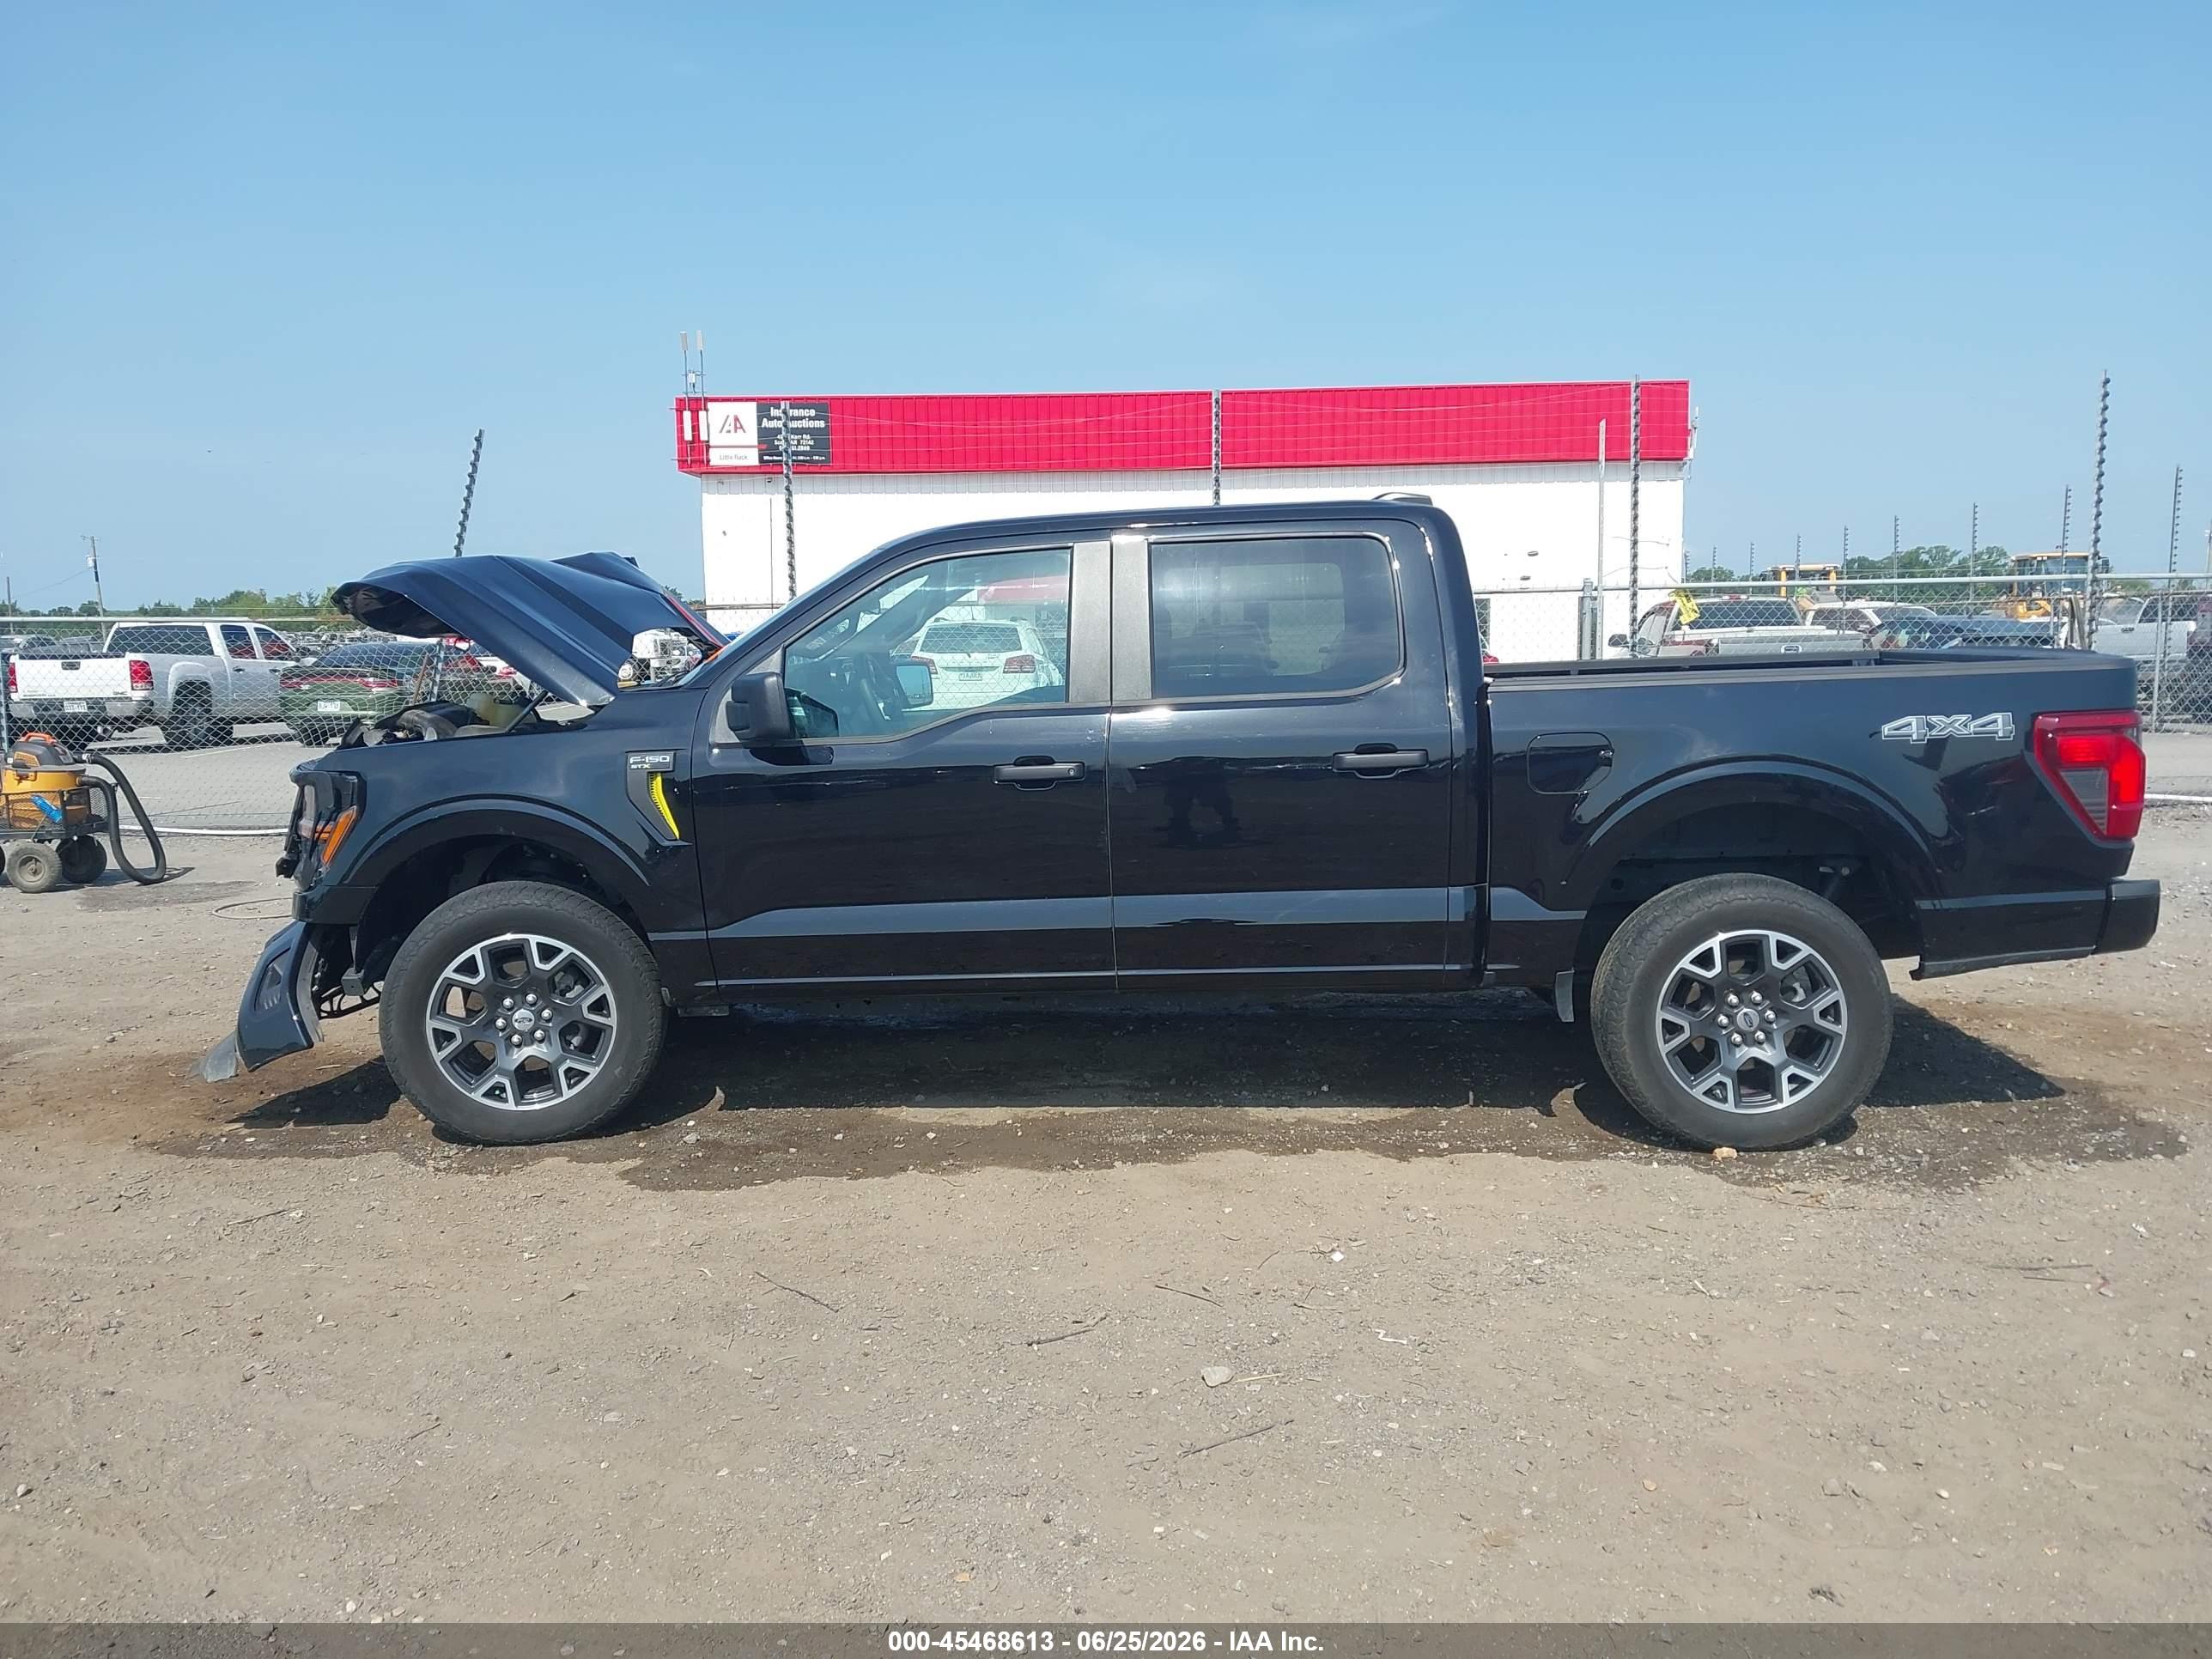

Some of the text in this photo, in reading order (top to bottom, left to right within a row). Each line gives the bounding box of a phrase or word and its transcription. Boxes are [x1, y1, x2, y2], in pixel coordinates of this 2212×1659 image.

[769, 406, 816, 416] Insrance
[761, 417, 825, 428] Auto uctions
[629, 755, 670, 764] F-150
